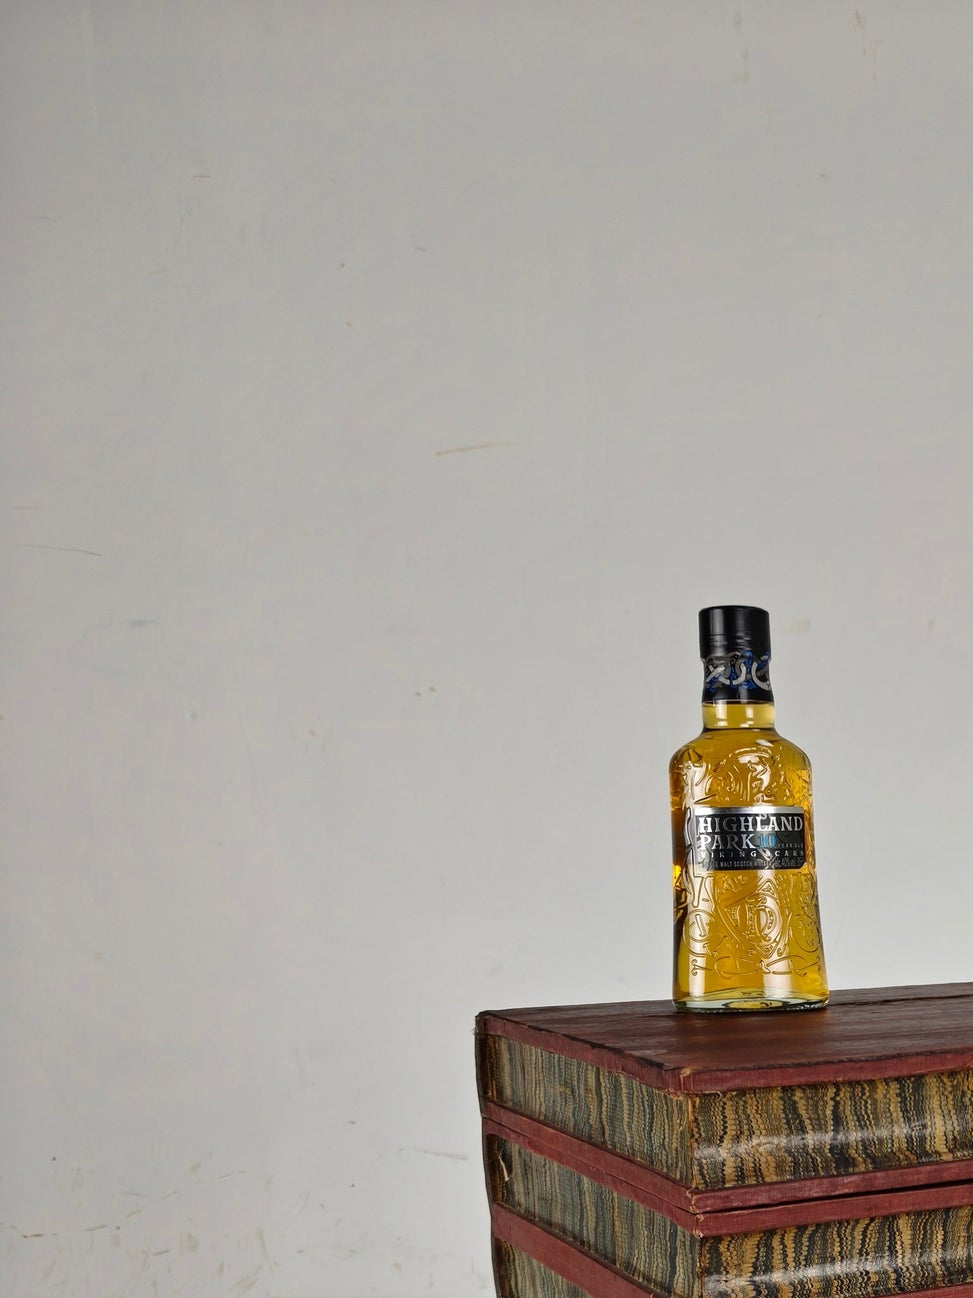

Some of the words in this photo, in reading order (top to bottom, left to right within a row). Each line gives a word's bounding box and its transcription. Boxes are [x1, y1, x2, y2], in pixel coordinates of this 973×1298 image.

[698, 816, 803, 832] HIGHLAND
[699, 834, 757, 851] PARK
[758, 833, 777, 848] 10
